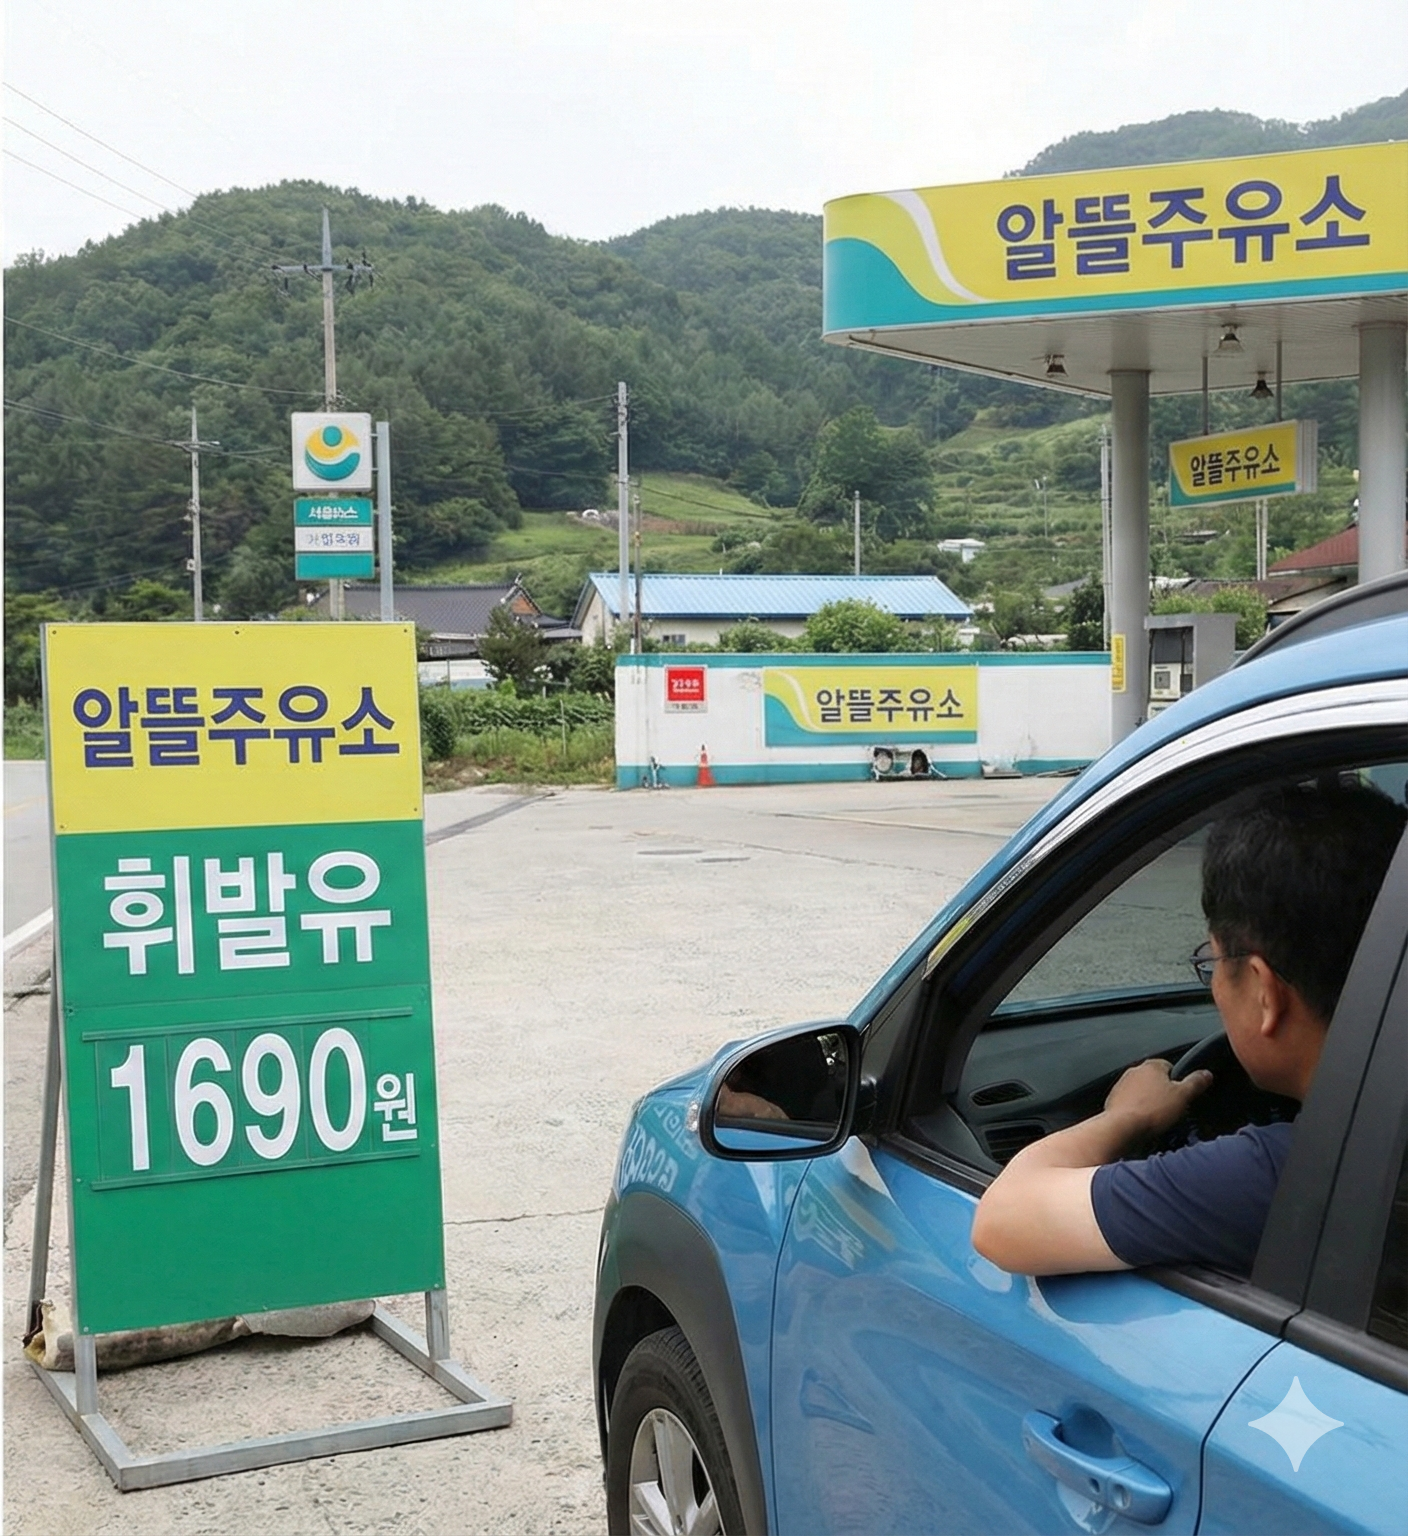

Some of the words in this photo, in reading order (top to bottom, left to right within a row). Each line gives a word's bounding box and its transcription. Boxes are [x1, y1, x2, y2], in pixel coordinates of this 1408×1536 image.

[996, 174, 1370, 281] 알뜰주유소
[1190, 443, 1280, 487] 알뜰주유소
[72, 685, 400, 769] 알뜰주유소
[816, 688, 964, 723] 알뜰주유소
[103, 850, 392, 976] 휘발유
